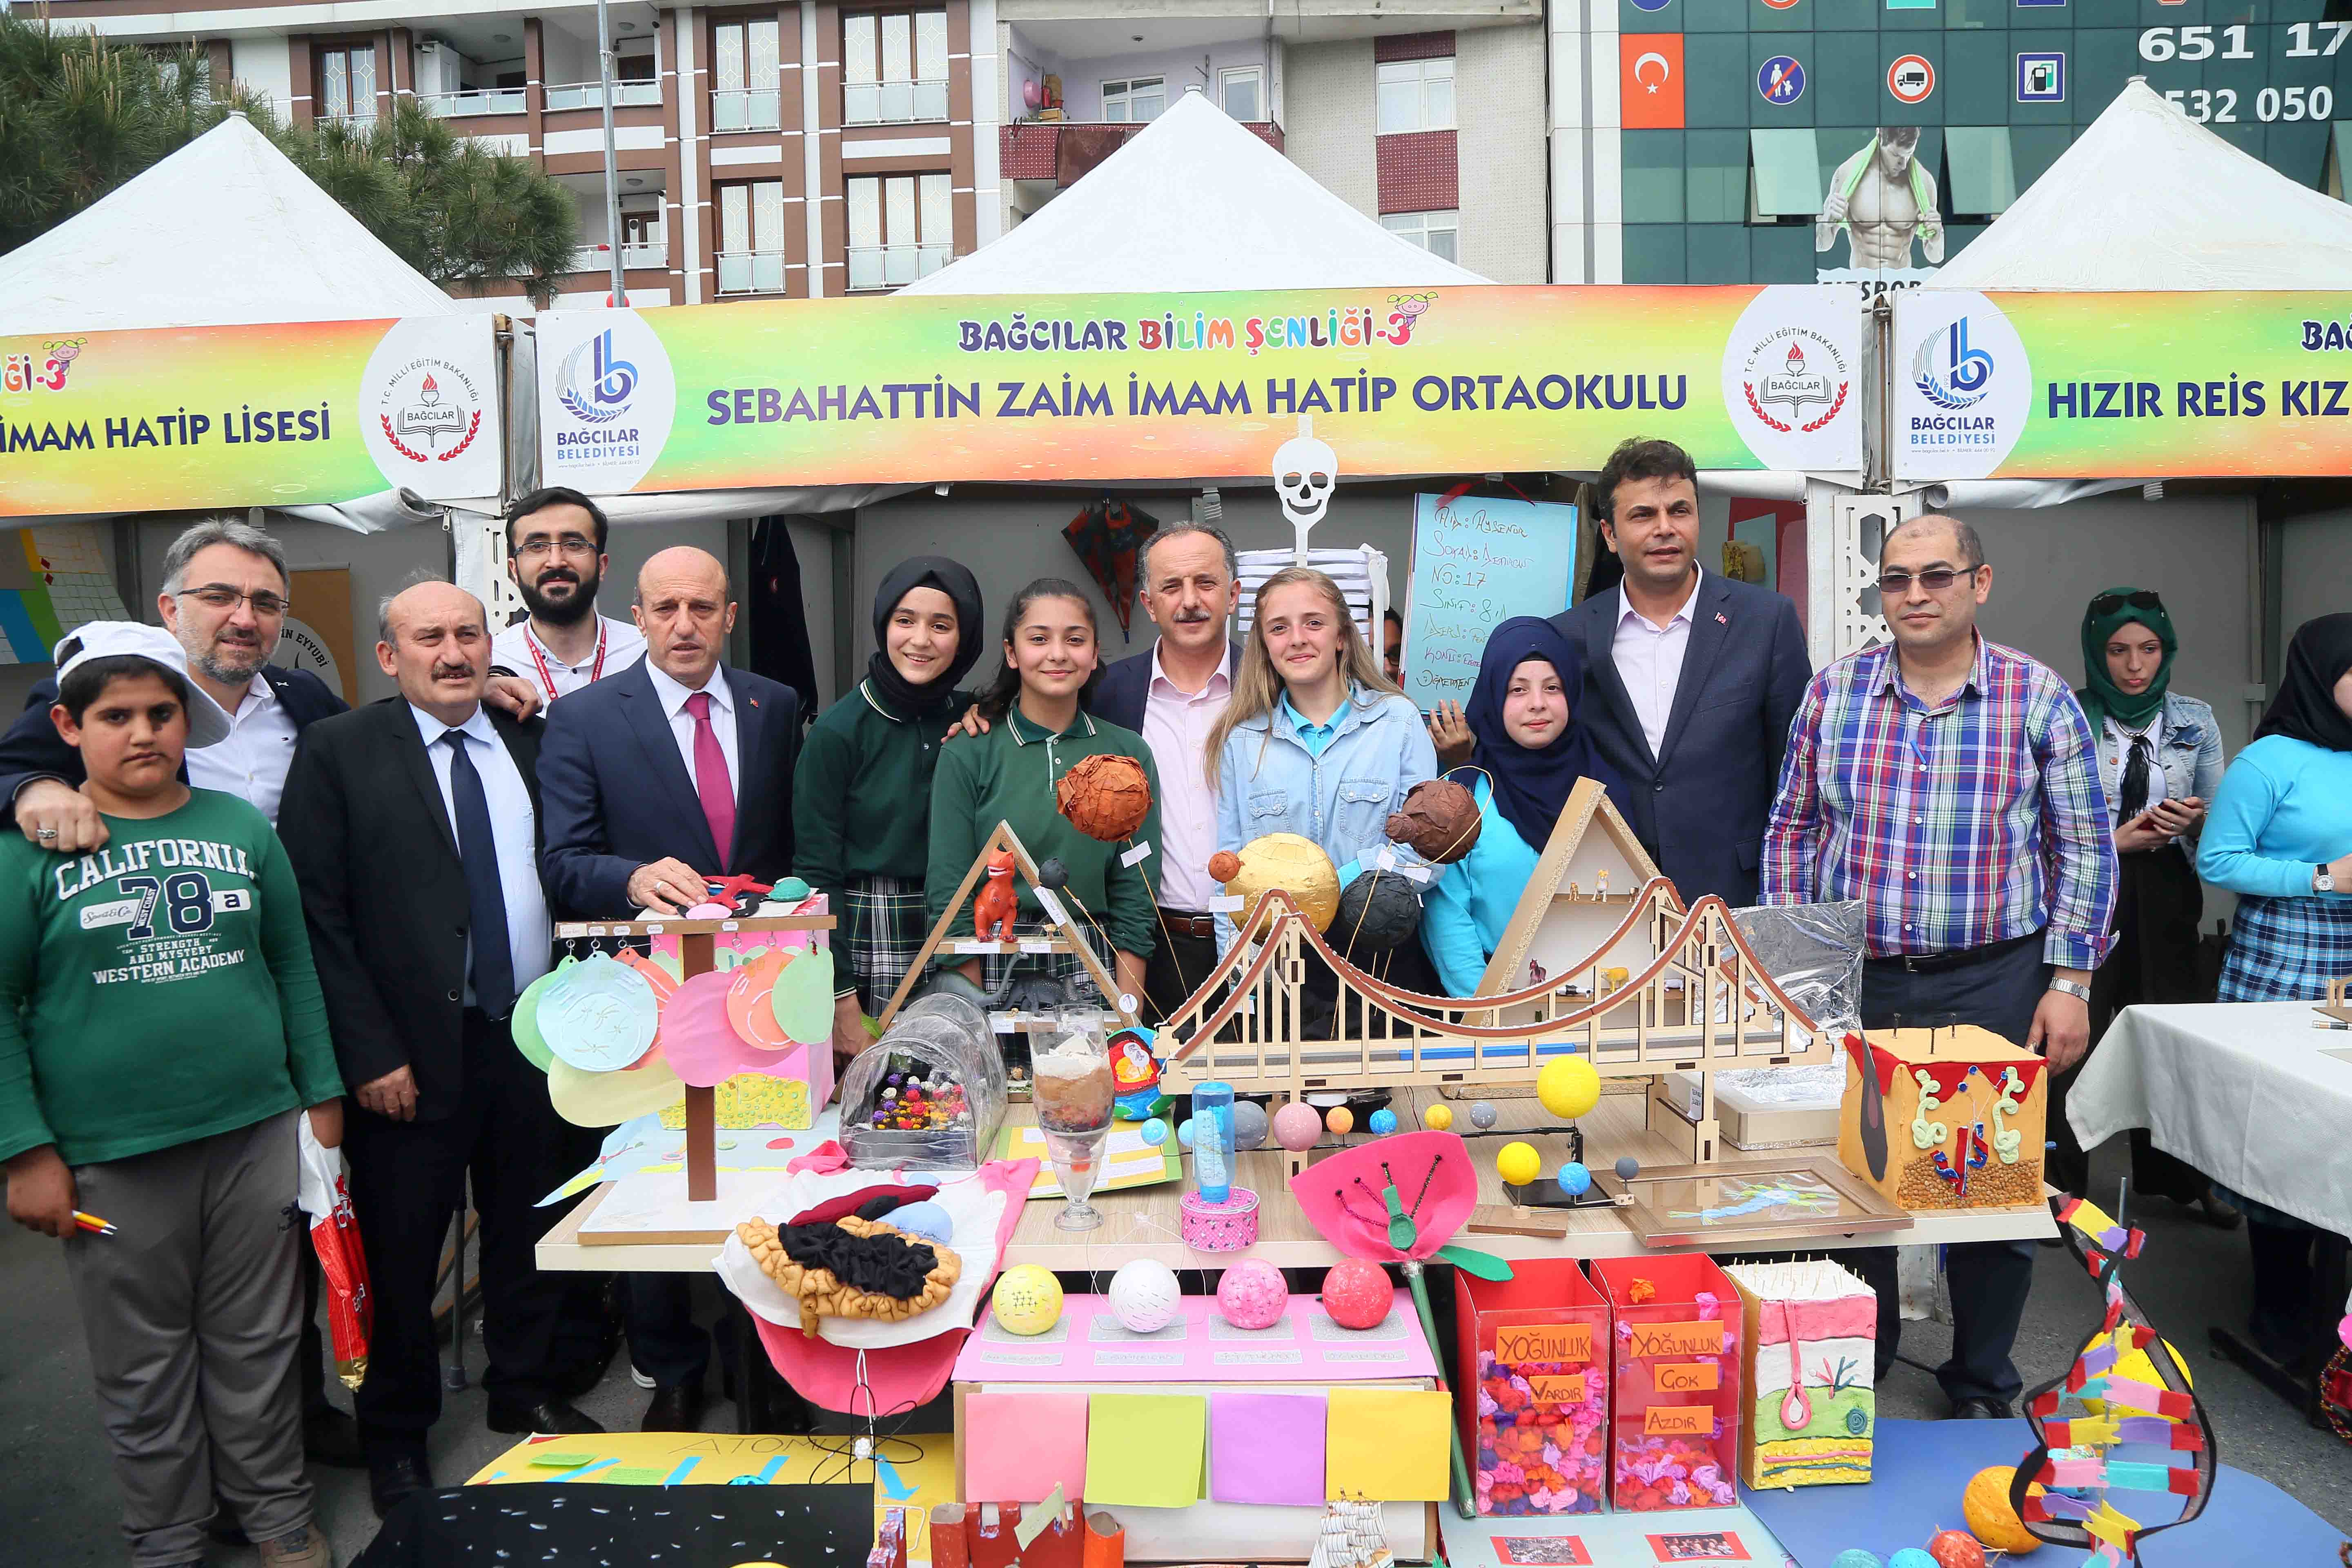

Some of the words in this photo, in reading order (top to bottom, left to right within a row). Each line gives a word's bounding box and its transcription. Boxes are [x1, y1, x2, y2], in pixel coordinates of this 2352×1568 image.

[2138, 25, 2254, 62] 651
[2256, 85, 2333, 122] 050
[958, 313, 1127, 352] BAĞCILAR
[1138, 312, 1235, 350] BİLİM
[1753, 332, 1775, 356] MİLLİ
[1776, 327, 1808, 339] EĞİTİM
[1810, 332, 1846, 373] BAKANLIĞI
[388, 365, 410, 388] MİLLİ
[410, 356, 441, 371] EĞİTİM
[443, 361, 479, 402] BAKANLIĞI
[1771, 380, 1820, 390] BAĞCILAR
[707, 374, 980, 425] SEBAHATTİN
[997, 372, 1114, 418] ZAİM
[1129, 371, 1252, 416] İMAM
[1267, 368, 1397, 414] HATİP
[1412, 374, 1687, 412] ORTAOKULU
[2049, 383, 2163, 419] HIZIR
[2177, 372, 2266, 418] REİS
[2281, 381, 2350, 416] KIZ
[105, 407, 210, 449] HATİP
[223, 401, 331, 443] LİSESİ
[408, 410, 454, 421] BAĞCILAR
[1911, 413, 1995, 430] BAĞCILAR
[557, 427, 639, 445] BAĞCILAR
[558, 443, 639, 460] BELEDİYESİ
[1911, 431, 1995, 444] BELEDİYESİ
[1463, 572, 1486, 590] 17
[296, 633, 330, 668] EYYUBİ
[117, 871, 214, 940] 78
[136, 909, 149, 927] WEST
[143, 888, 156, 909] COAST
[224, 894, 241, 908] a
[129, 953, 154, 964] AND
[158, 945, 212, 960] MYSTERY
[140, 938, 200, 953] STRENGTH
[93, 960, 175, 984] WESTERN
[180, 949, 245, 973] ACADEMY
[1499, 1332, 1590, 1361] YOĞUNLUK
[1633, 1332, 1721, 1356] YOĞUNLUK
